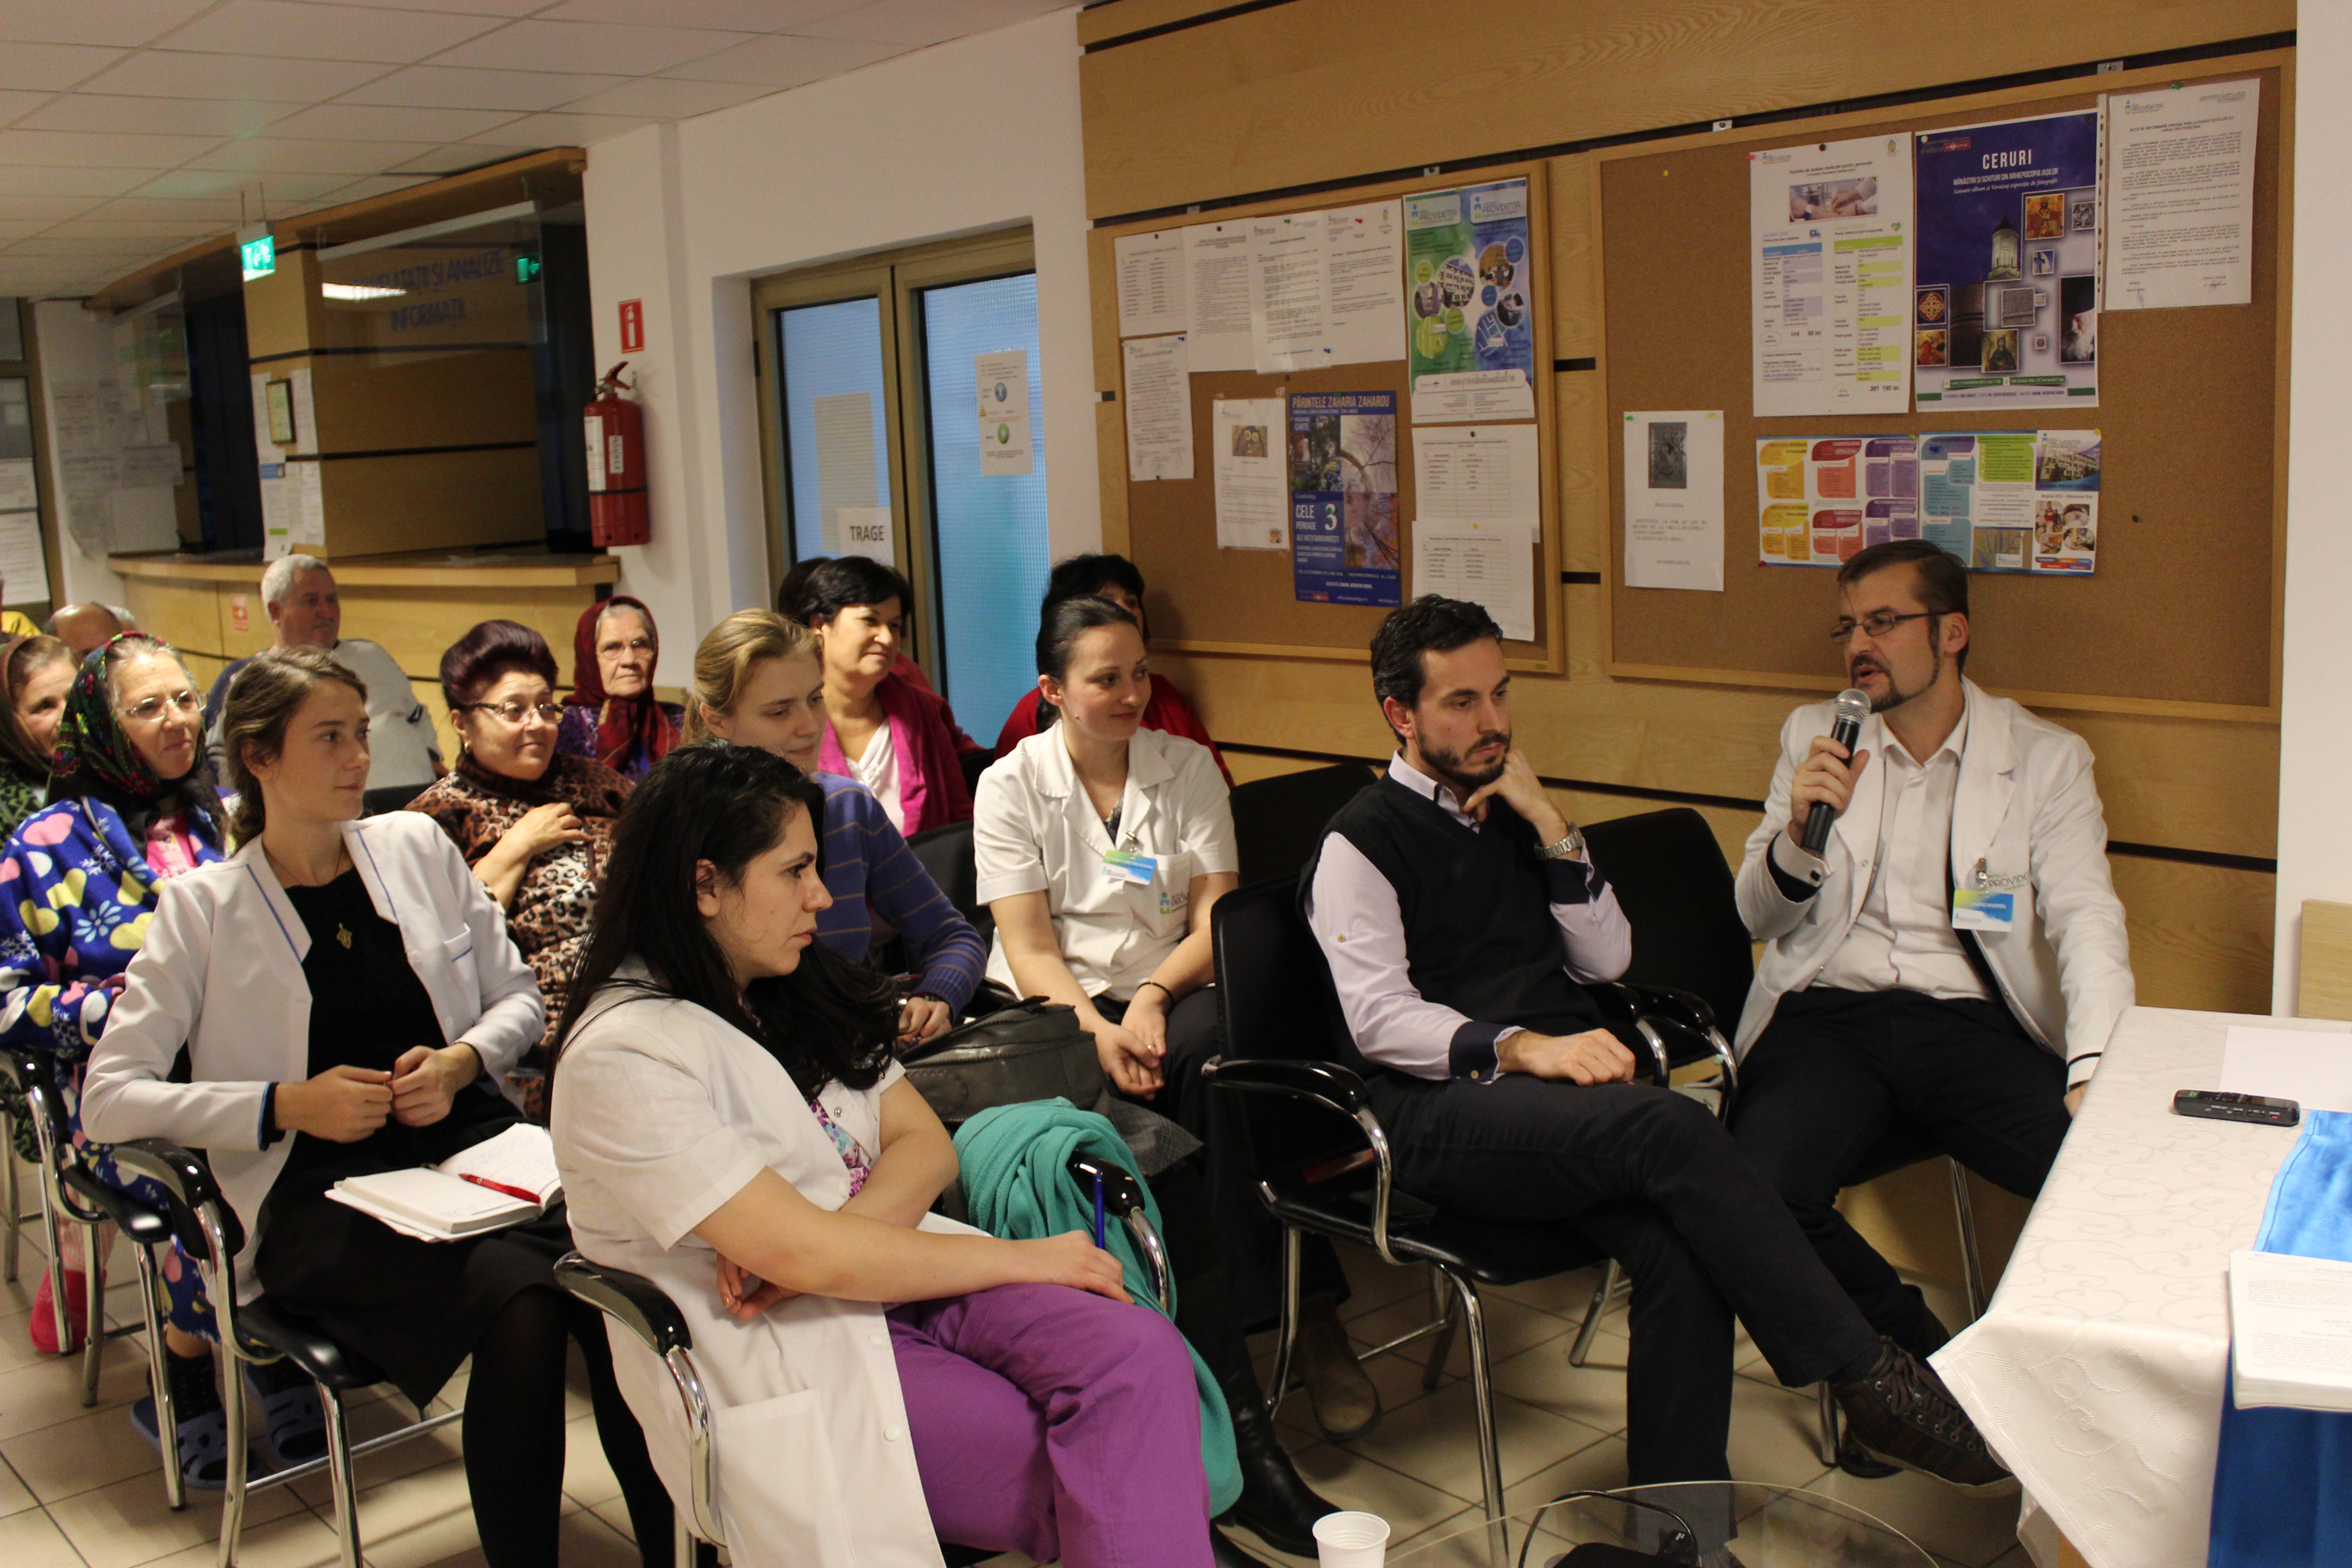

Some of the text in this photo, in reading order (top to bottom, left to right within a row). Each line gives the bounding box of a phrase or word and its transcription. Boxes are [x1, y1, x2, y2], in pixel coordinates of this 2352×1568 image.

[1982, 148, 2032, 170] CERURI
[1293, 395, 1390, 408] PĂRINTELE ZAHARIA ZAHAROU
[1296, 504, 1315, 518] CELE
[1324, 503, 1338, 530] 3
[849, 525, 884, 542] TRAGE
